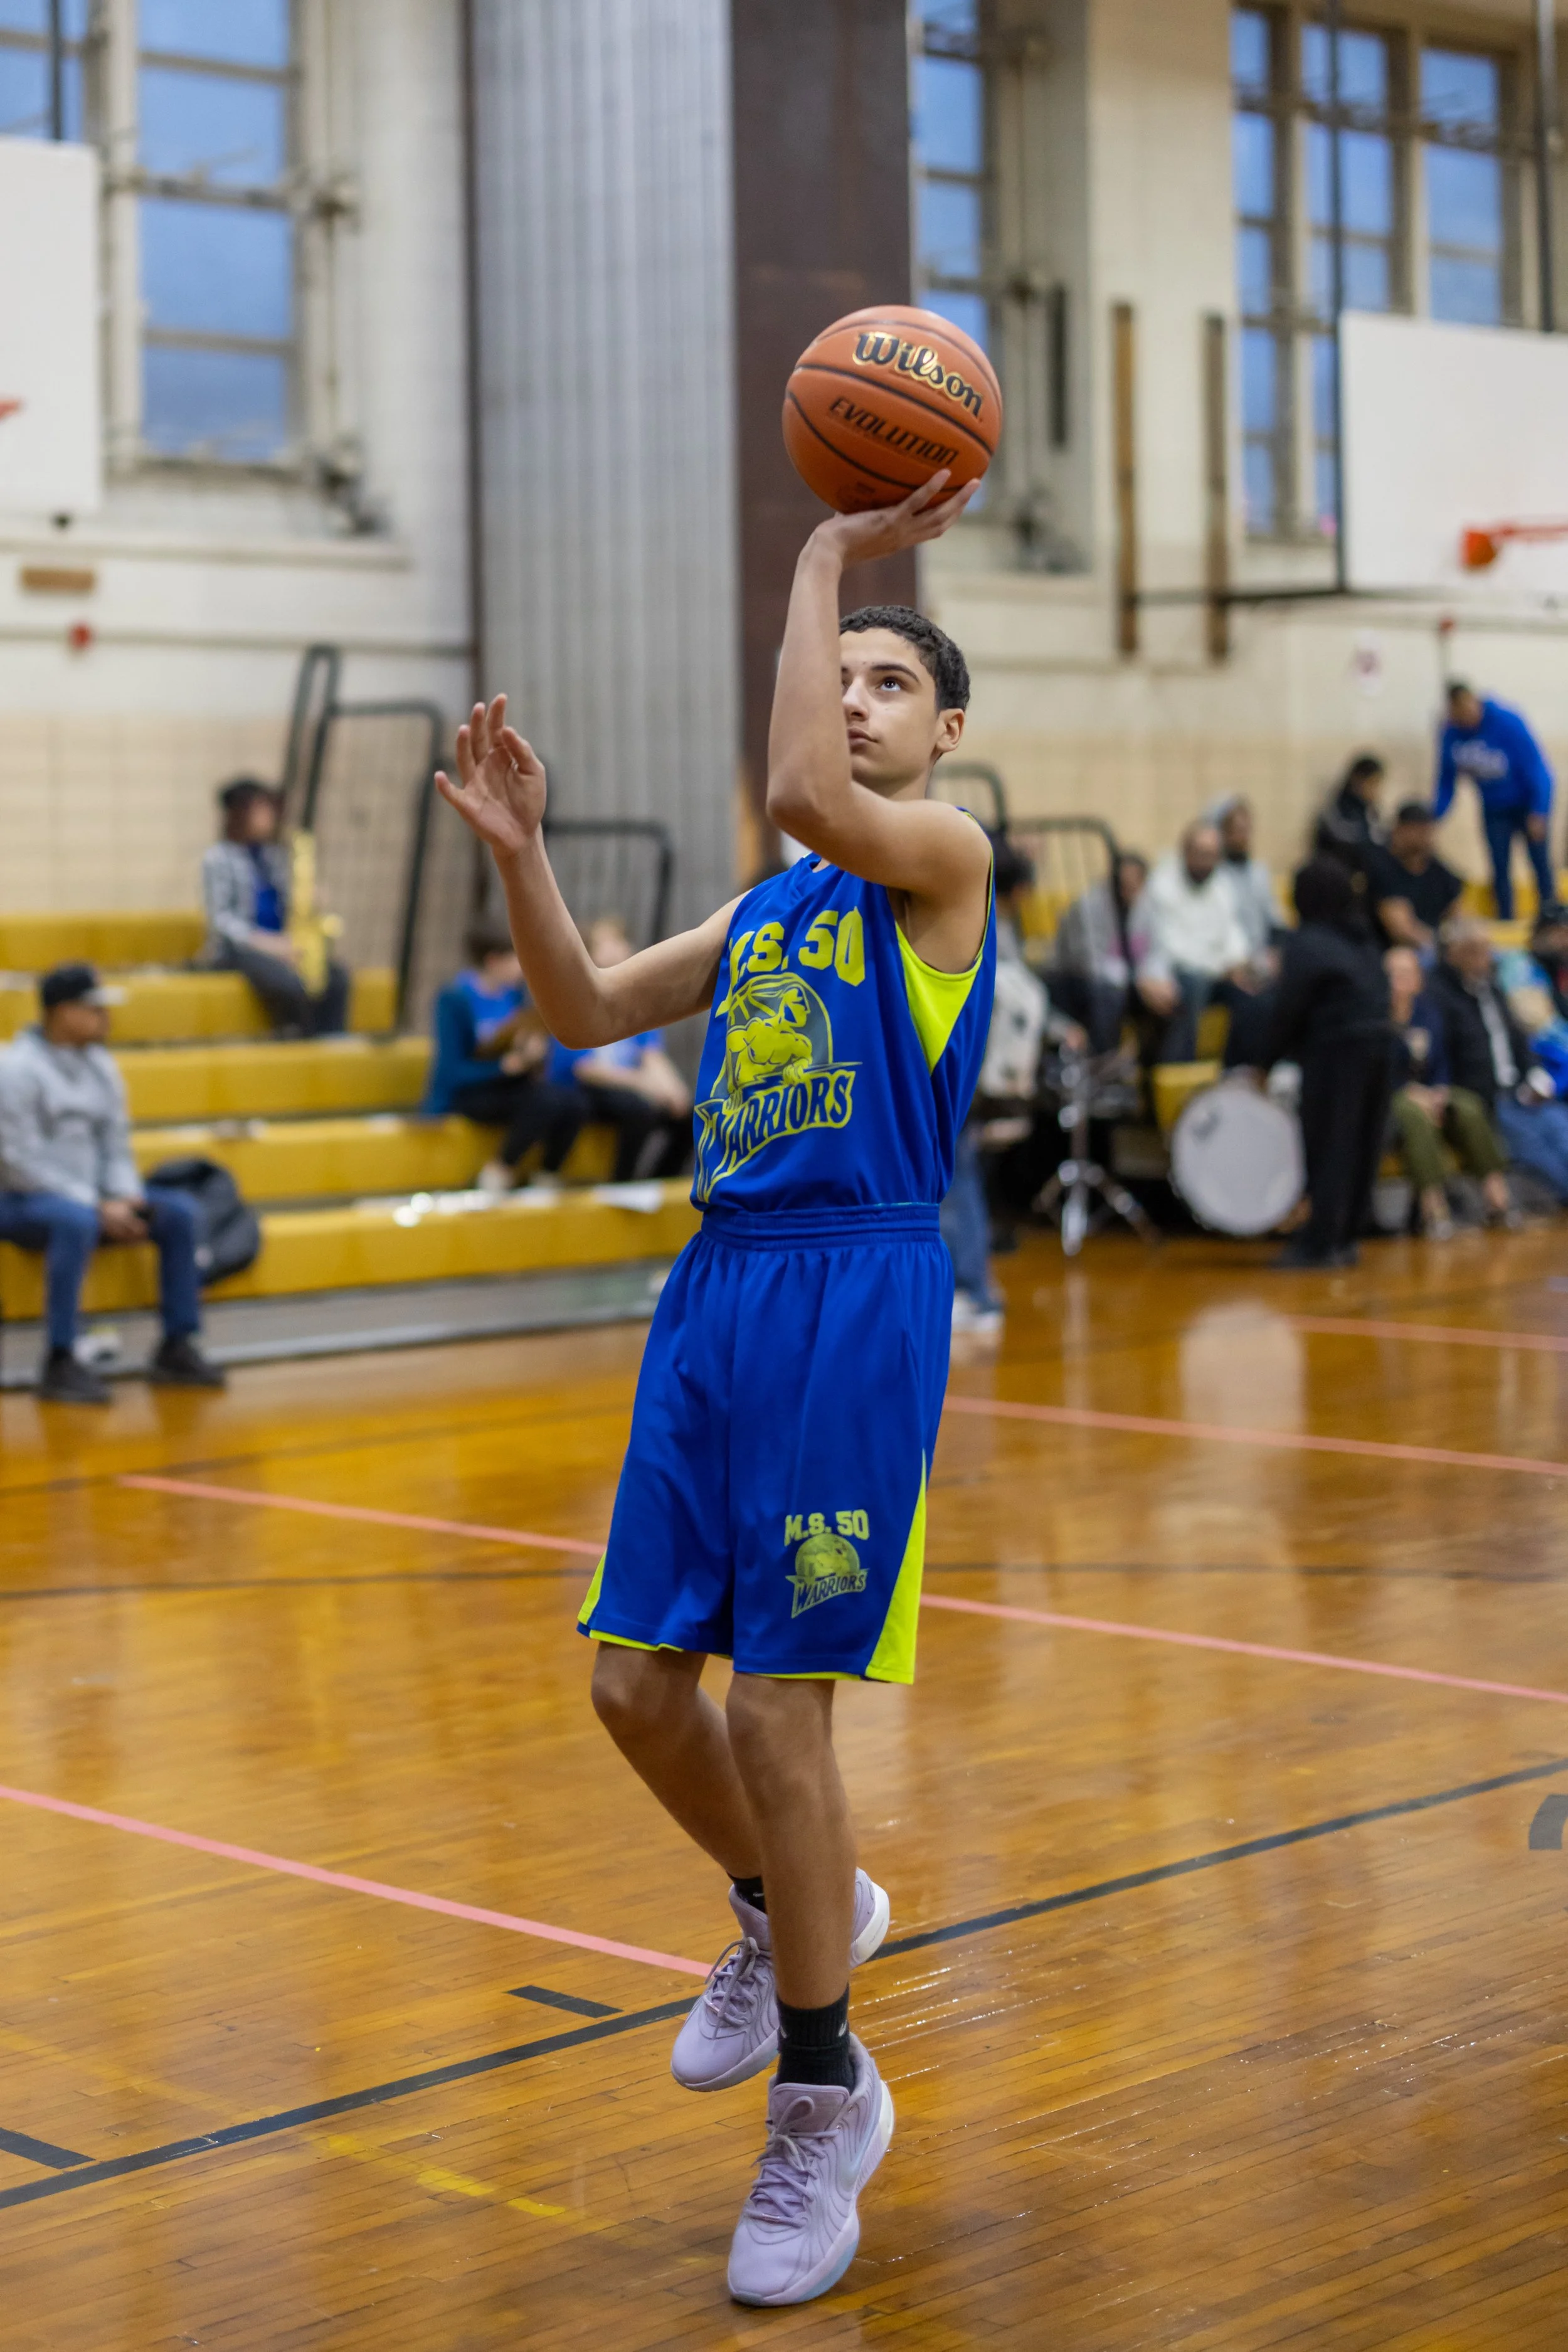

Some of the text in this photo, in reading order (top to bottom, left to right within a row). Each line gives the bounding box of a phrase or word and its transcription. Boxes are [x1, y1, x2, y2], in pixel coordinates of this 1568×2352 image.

[852, 331, 983, 418] Wilson
[829, 397, 959, 466] EVOLUTION
[798, 906, 866, 987] 50
[784, 1508, 870, 1547] M.S. 50
[787, 1571, 868, 1618] WARRIORS
